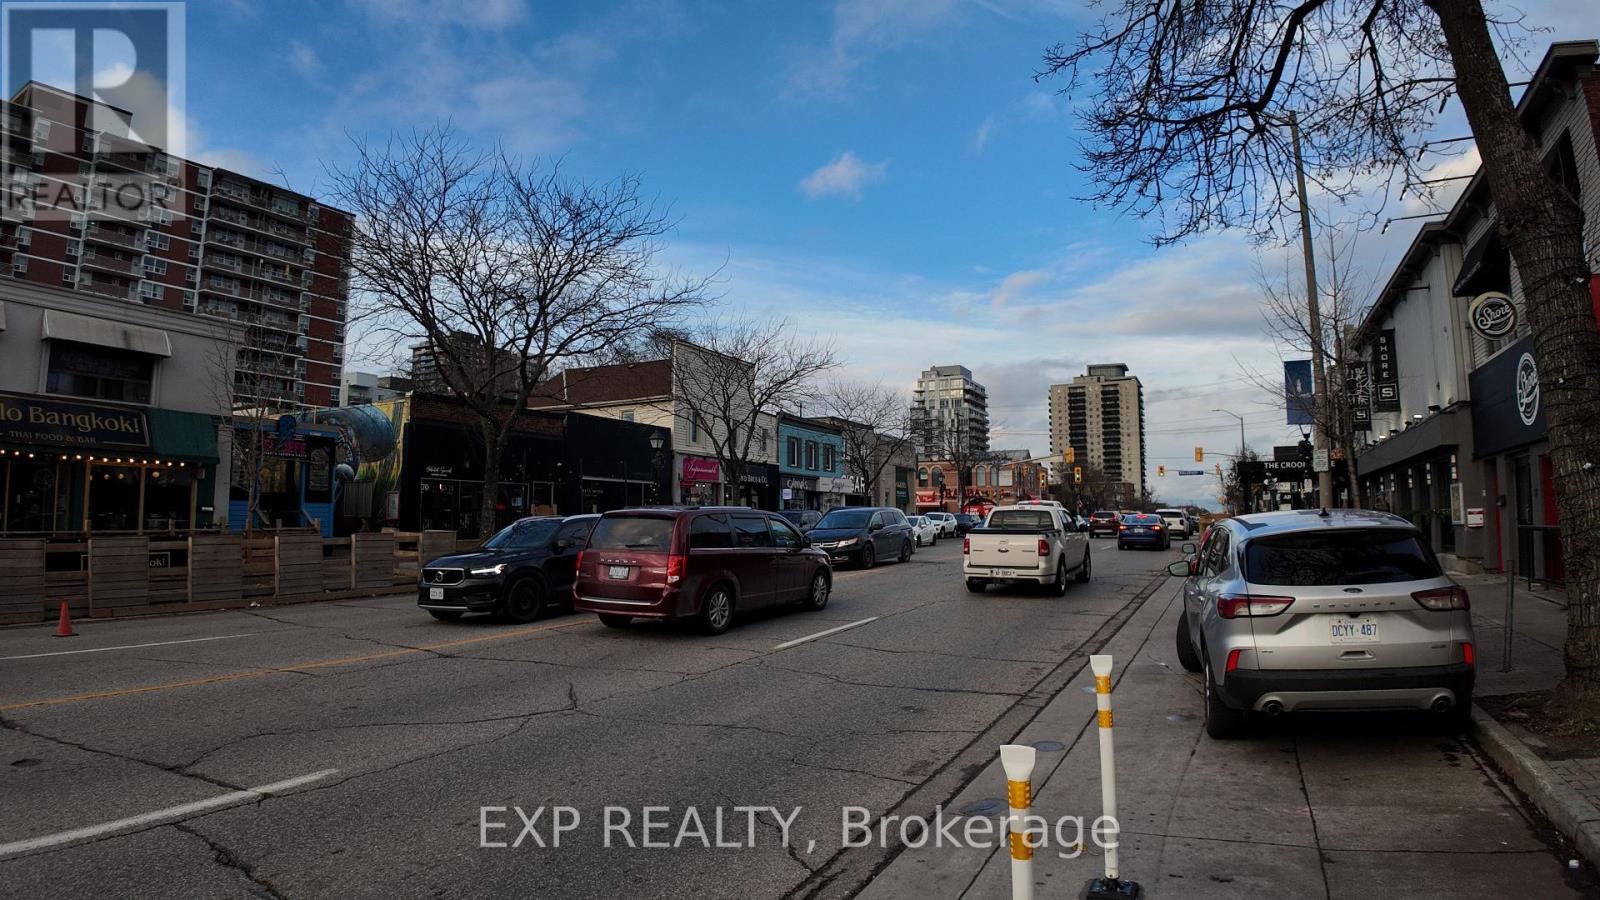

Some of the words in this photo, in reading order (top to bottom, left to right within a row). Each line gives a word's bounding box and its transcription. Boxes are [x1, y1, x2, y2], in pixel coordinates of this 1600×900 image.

[1478, 304, 1511, 330] Shore
[1379, 336, 1390, 378] SHORE
[0, 402, 23, 421] lo
[29, 406, 140, 433] Bangkok!
[8, 430, 33, 440] THAI
[35, 432, 64, 442] FOOD
[78, 436, 97, 444] BAR
[1263, 462, 1280, 470] THE
[1280, 461, 1306, 470] CROO
[149, 557, 166, 567] ok!
[1332, 625, 1354, 637] DCYY
